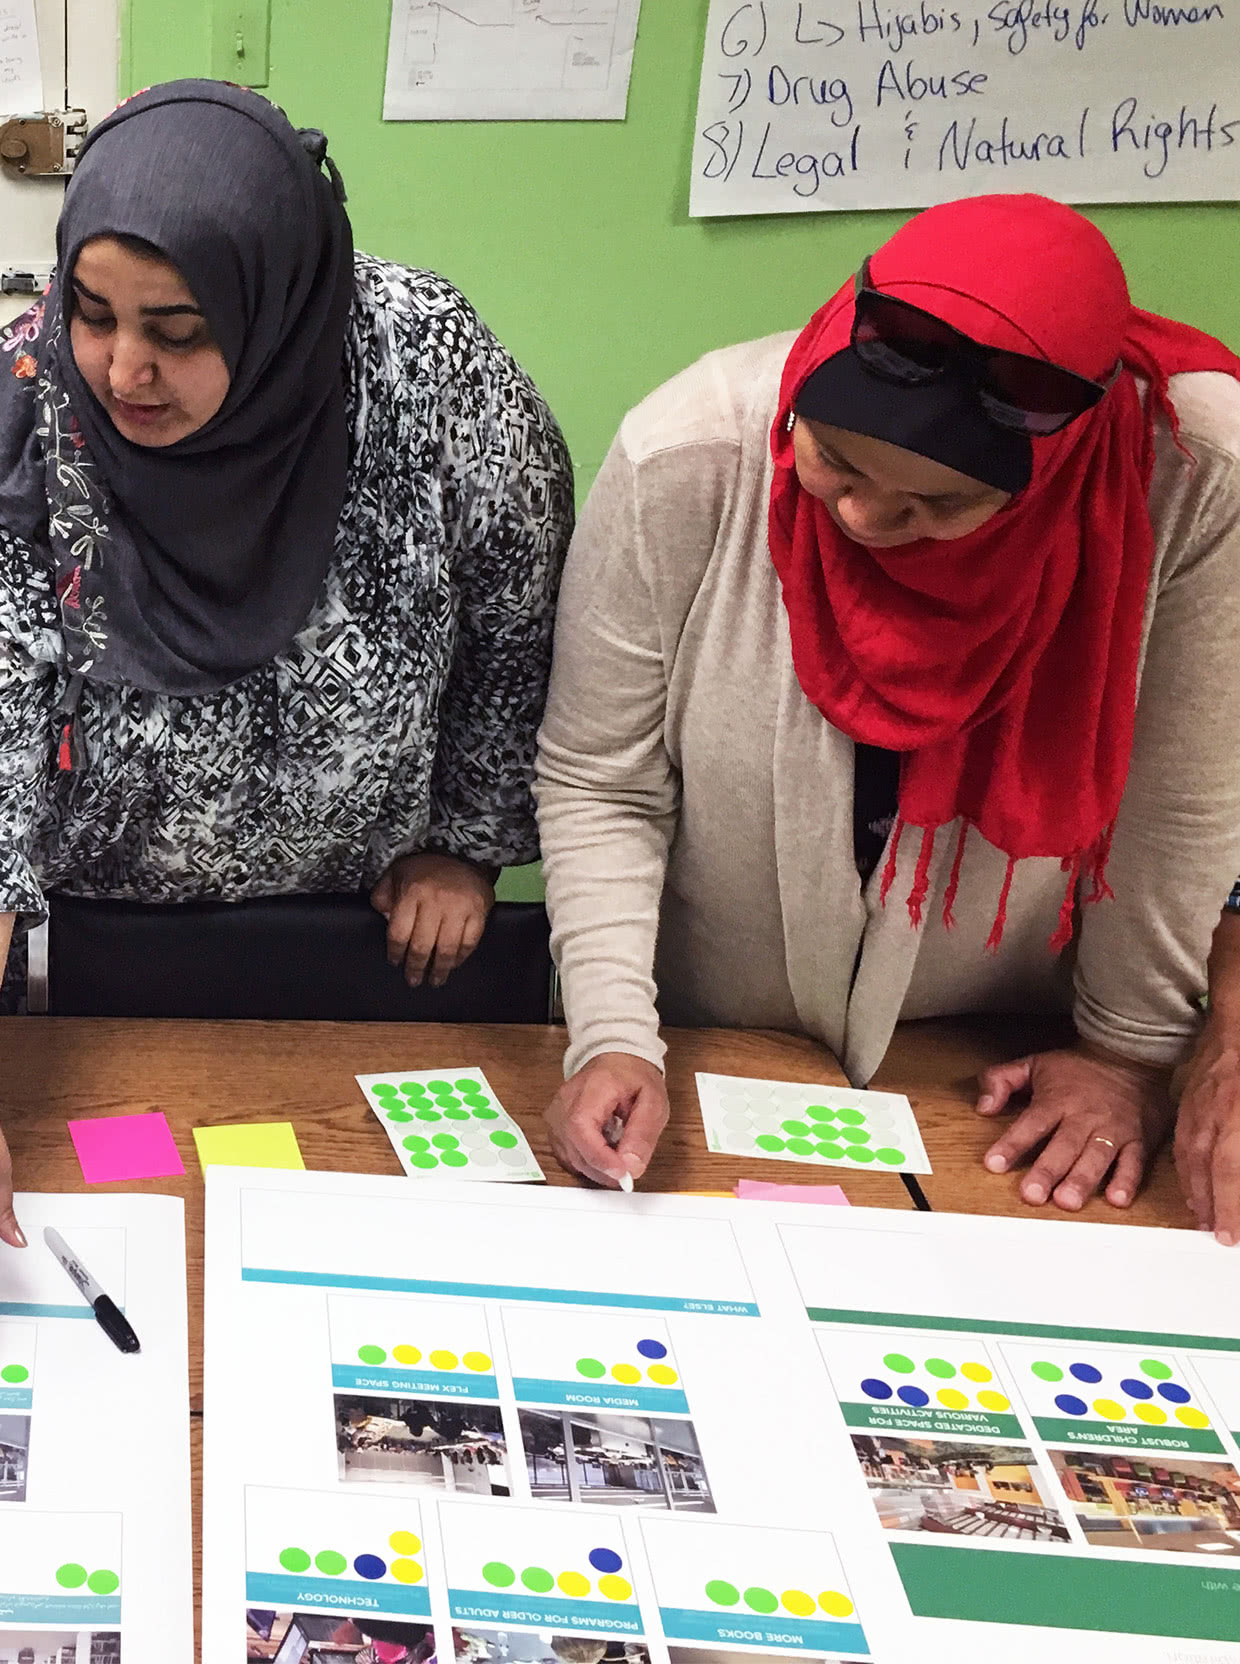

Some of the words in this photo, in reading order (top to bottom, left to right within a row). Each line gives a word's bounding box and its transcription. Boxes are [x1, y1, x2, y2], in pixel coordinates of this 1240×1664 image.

[767, 65, 850, 127] Drug
[876, 60, 989, 108] Abuse
[702, 120, 742, 182] 8)
[752, 124, 860, 197] Legal
[938, 106, 1088, 172] Natural
[1112, 97, 1240, 178] Rights
[683, 1302, 714, 1310] ELSE?
[717, 1304, 748, 1313] WHAT
[355, 1378, 389, 1388] SPACE
[392, 1380, 439, 1391] MEETING
[442, 1384, 469, 1394] FLEX
[565, 1394, 600, 1404] ROOM
[602, 1398, 639, 1406] MEDIA
[871, 1406, 934, 1418] ACTIVITIES
[934, 1410, 989, 1422] VARIOUS
[868, 1416, 892, 1426] FOR
[894, 1418, 932, 1430] SPACE
[934, 1420, 1001, 1434] DEDICATED
[1106, 1424, 1138, 1434] AREA
[1140, 1436, 1190, 1448] ROBUST
[1200, 1580, 1228, 1592] with
[296, 1592, 379, 1608] TECHNOLOGY
[454, 1606, 500, 1618] ADULTS
[502, 1610, 542, 1622] OLDER
[544, 1614, 568, 1624] FOR
[570, 1616, 638, 1630] PROGRAMS
[716, 1628, 762, 1642] BOOKS
[765, 1632, 803, 1644] MORE
